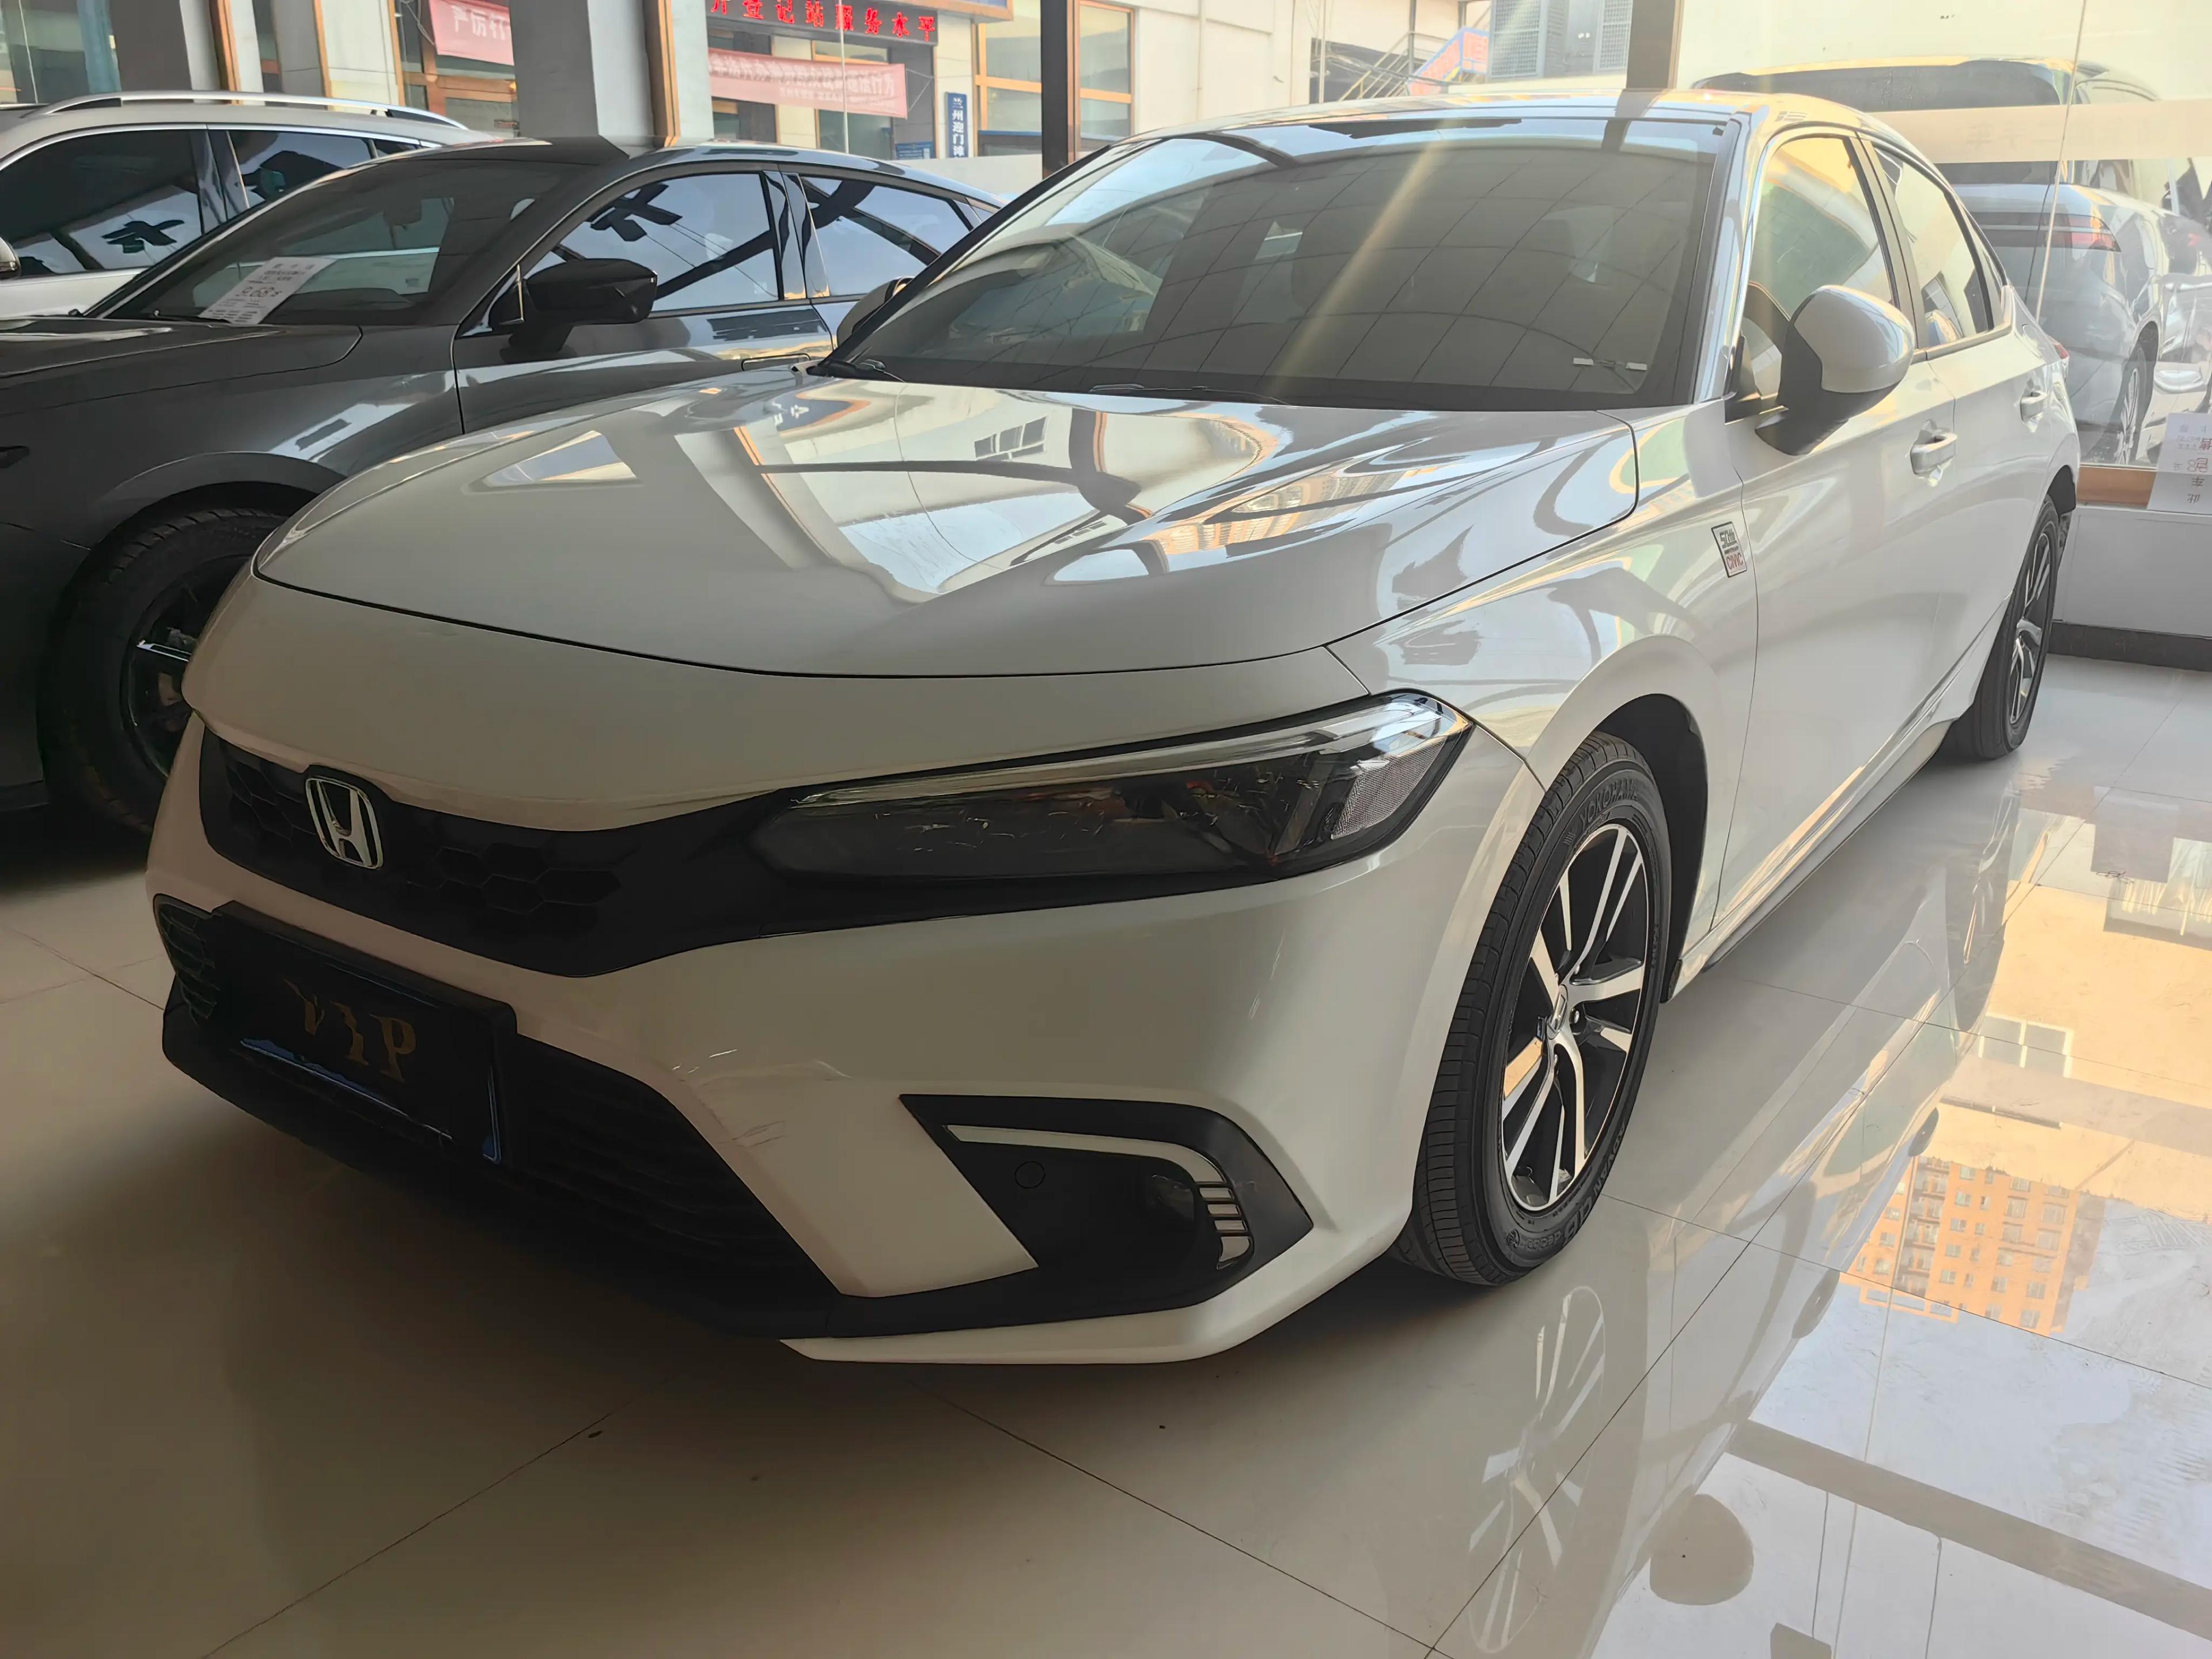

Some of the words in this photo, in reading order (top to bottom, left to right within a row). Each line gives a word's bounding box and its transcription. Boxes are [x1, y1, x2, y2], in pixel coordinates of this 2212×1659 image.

[451, 5, 508, 40] 严厉打
[952, 97, 965, 157] 兰州迎门滩
[1726, 552, 1743, 570] CIVIC
[282, 978, 416, 1082] VIP
